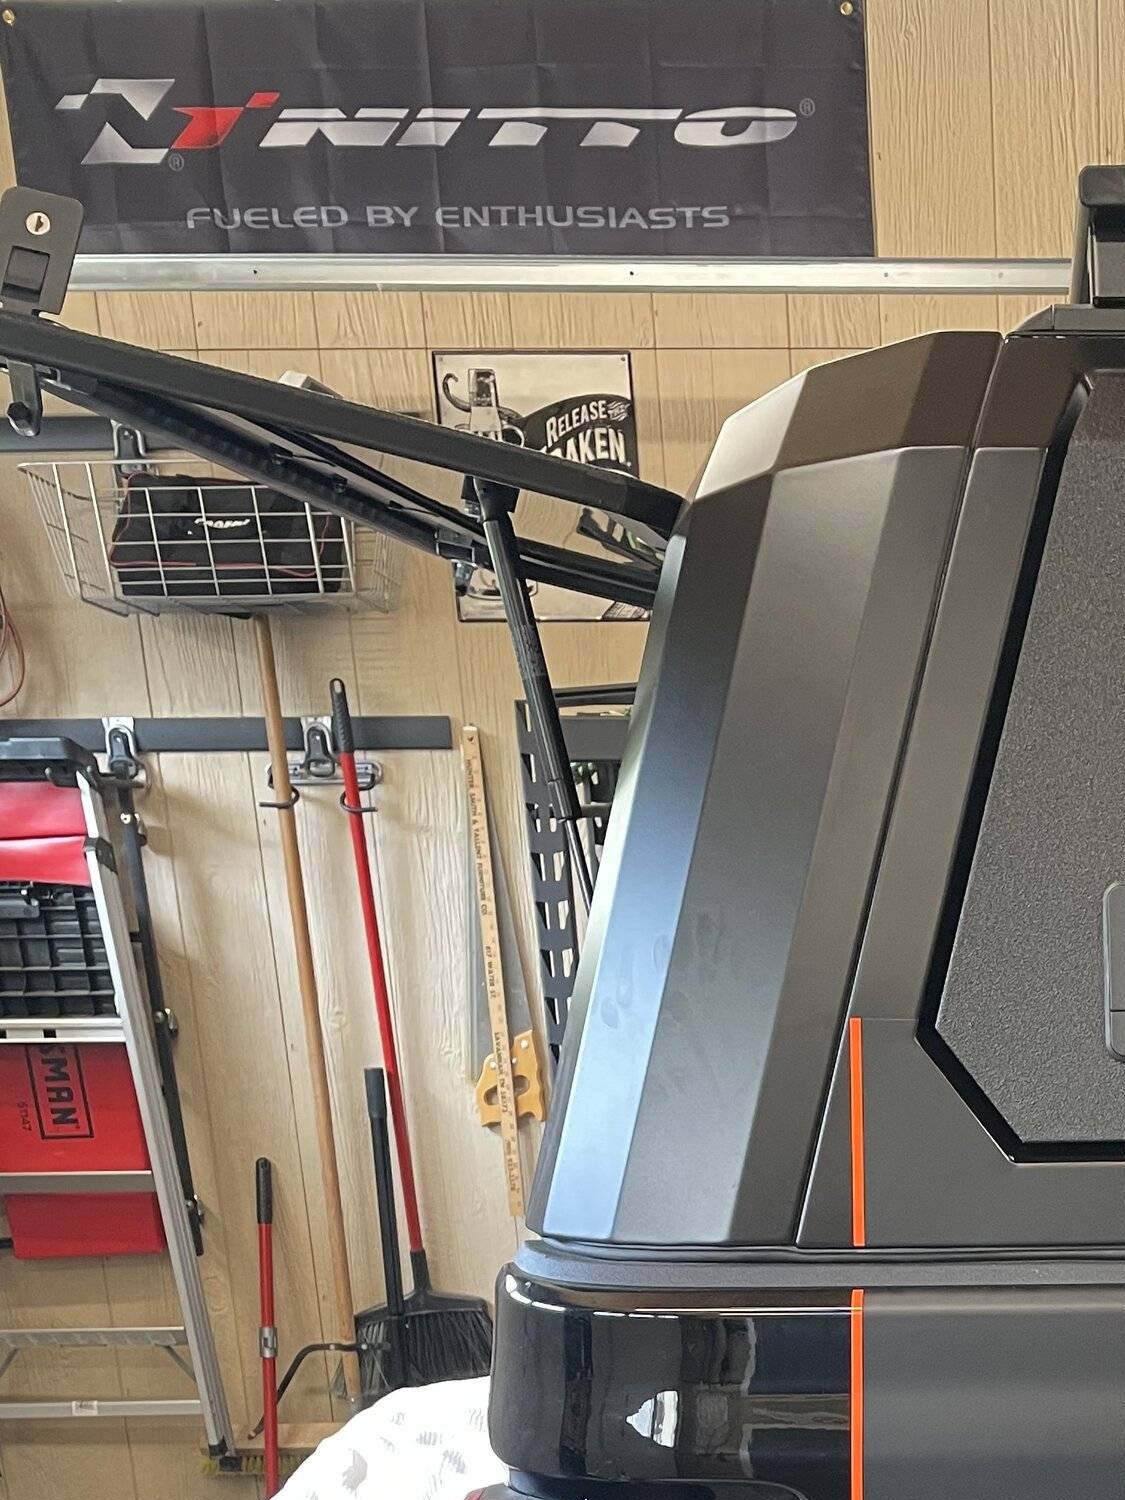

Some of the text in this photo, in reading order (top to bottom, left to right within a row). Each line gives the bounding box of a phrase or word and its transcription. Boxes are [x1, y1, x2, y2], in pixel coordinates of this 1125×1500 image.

[259, 106, 798, 148] NITTO
[186, 205, 730, 230] FUELED BY ENTHUSIASTS
[545, 400, 608, 448] RELEASE
